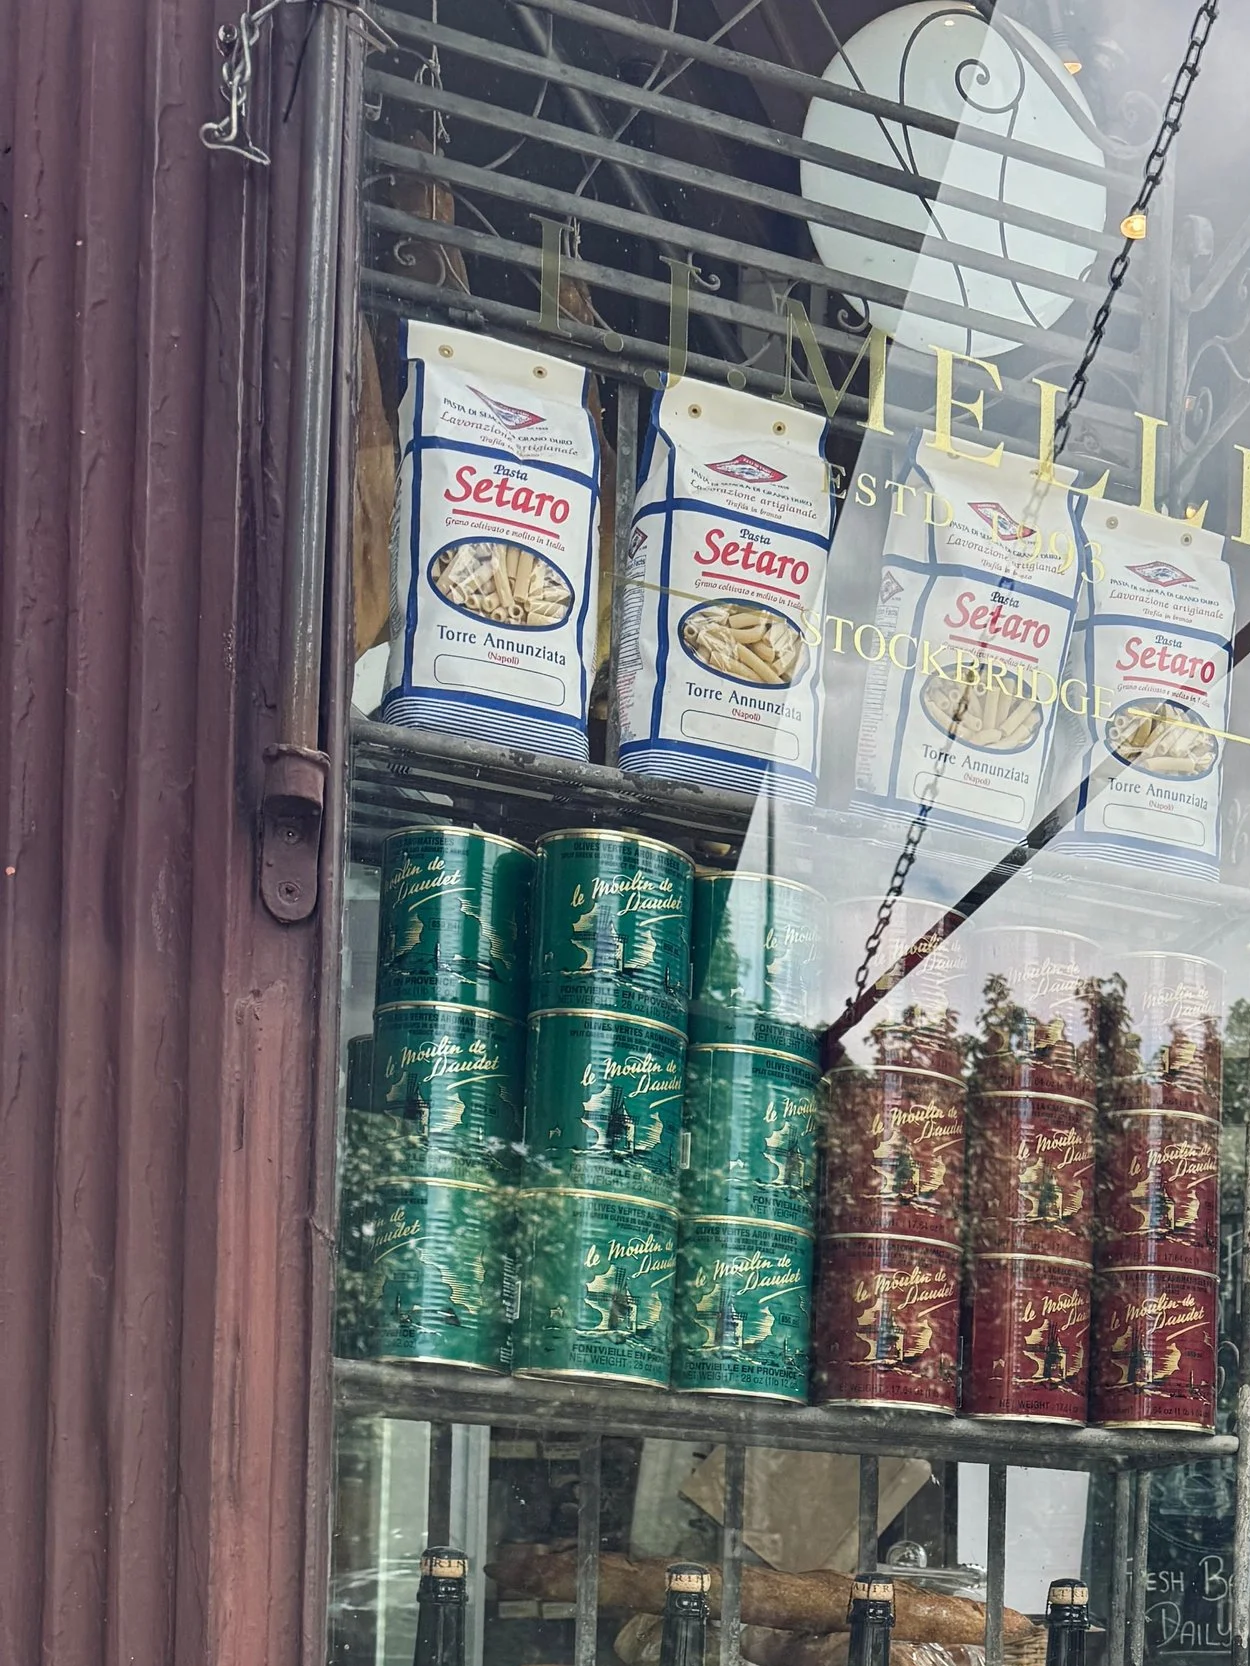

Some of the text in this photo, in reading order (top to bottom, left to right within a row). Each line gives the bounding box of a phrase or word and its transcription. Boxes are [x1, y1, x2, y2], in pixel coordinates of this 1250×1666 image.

[493, 464, 529, 481] Pasta
[444, 466, 570, 524] Setaro
[760, 498, 817, 520] artigianale
[445, 517, 469, 527] Grano
[471, 521, 504, 534] coltivato
[511, 530, 535, 542] molito
[536, 536, 544, 544] in
[545, 539, 565, 552] Italia
[739, 528, 772, 545] Pasta
[821, 462, 953, 527] ESTD
[990, 510, 1104, 584] 1993
[693, 528, 809, 585] Setaro
[694, 578, 717, 589] Grano
[718, 581, 750, 595] coltivato
[990, 591, 1020, 608] Pasta
[1109, 589, 1224, 620] Lavorazione artigianale
[943, 591, 1051, 649] Setaro
[437, 624, 566, 666] Torre Annunziata
[1155, 634, 1183, 649] Pasta
[487, 651, 520, 665] (Napoli)
[801, 609, 1115, 722] STOCKBRIDGE
[1115, 636, 1216, 684] Setaro
[686, 682, 802, 722] Torre Annunziata
[731, 708, 761, 722] (Napoli)
[922, 743, 1030, 785] Torre Annunziata
[963, 773, 991, 786] (Napoli)
[1108, 777, 1208, 811] Torre Annunziata
[1148, 800, 1174, 812] (Napoli)
[574, 842, 600, 851] OLIVES
[428, 856, 445, 871] de
[571, 869, 673, 908] le Moulin de
[617, 891, 682, 917] Daudet
[764, 928, 778, 949] le
[584, 1021, 643, 1038] OLIVES VERTES
[400, 1035, 464, 1068] Moulin
[469, 1039, 486, 1054] de
[423, 1056, 500, 1083] Daudet
[581, 1053, 677, 1086] le Moulin de
[766, 1060, 790, 1072] OLIVES
[764, 1100, 778, 1123] le
[871, 1100, 958, 1135] le Moulin de
[1016, 1127, 1082, 1160] le Moulin
[1128, 1140, 1211, 1176] le Moulin de
[390, 1208, 405, 1222] de
[619, 1207, 646, 1218] VERTES
[722, 1227, 750, 1237] VERTES
[584, 1234, 662, 1267] le Moulin
[695, 1250, 791, 1288] le Moulin de
[737, 1268, 801, 1296] Daudet
[854, 1266, 946, 1303] le Moulin de
[898, 1282, 954, 1310] Daudet
[1022, 1289, 1085, 1323] le Moulin
[1110, 1293, 1196, 1331] le Moulin de
[1147, 1306, 1205, 1334] Daudet
[570, 1354, 586, 1362] NET
[591, 1355, 627, 1368] WEIGHT
[572, 1344, 645, 1359] FONTVIEILLE EN
[741, 1365, 755, 1373] EN
[756, 1366, 797, 1380] PROVENCE
[741, 1375, 752, 1384] 28
[753, 1377, 763, 1385] oz
